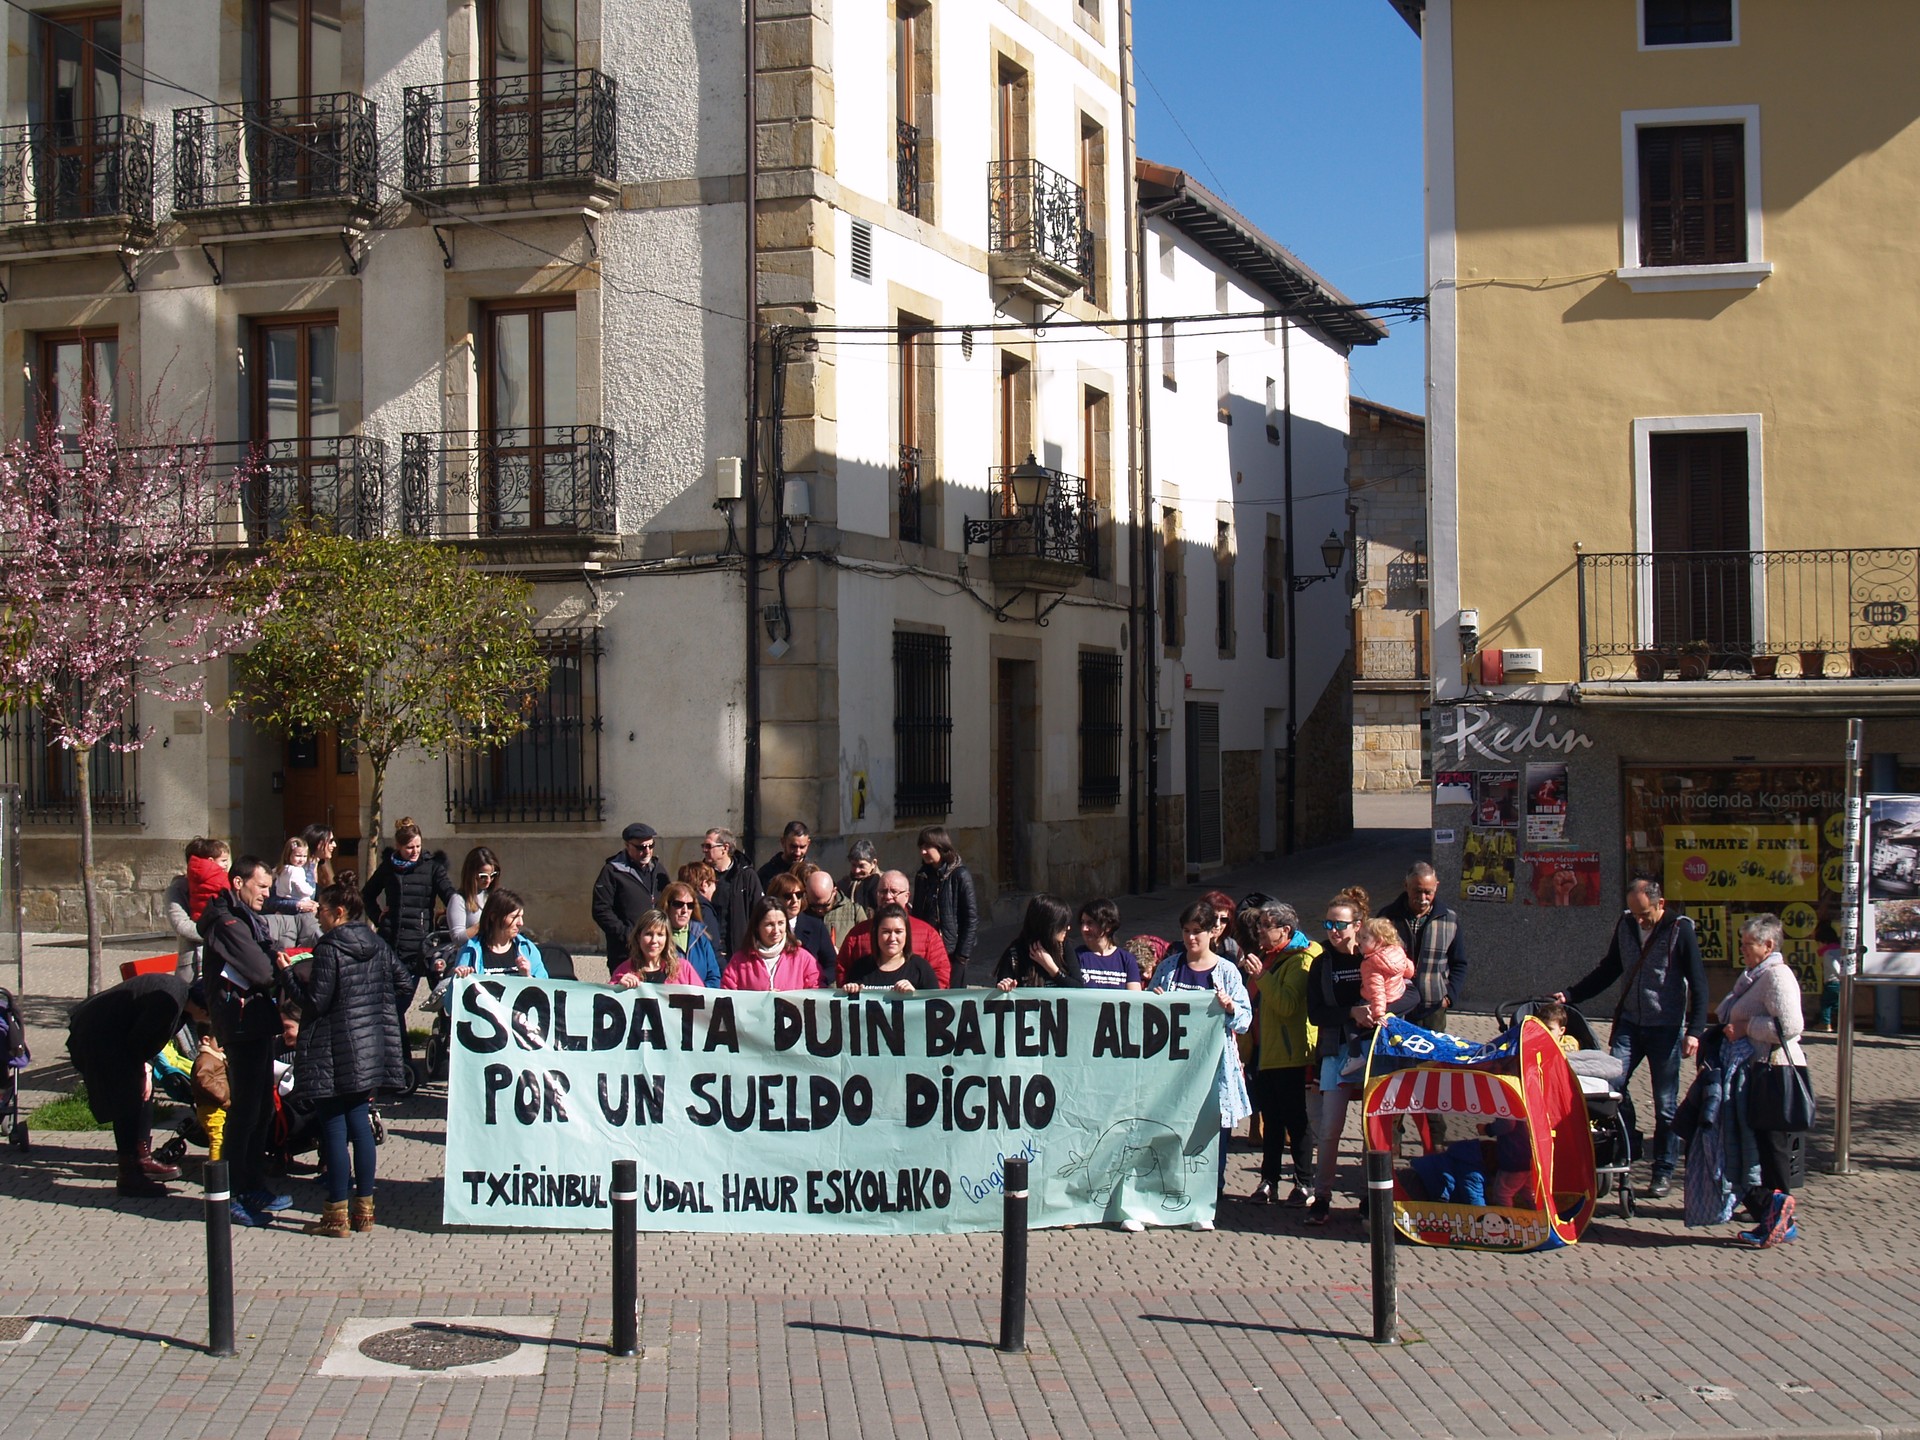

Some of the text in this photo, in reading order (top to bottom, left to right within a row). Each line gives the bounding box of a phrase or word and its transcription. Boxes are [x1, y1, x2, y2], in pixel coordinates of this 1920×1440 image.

[1868, 604, 1903, 622] 1883
[1440, 705, 1594, 763] Redin
[1674, 838, 1810, 850] REMATE FINAL
[1698, 907, 1714, 919] LI
[1795, 941, 1810, 953] LI
[1788, 952, 1816, 965] QUI
[456, 981, 740, 1053] SOLDATA
[925, 998, 1068, 1058] BATEN
[1093, 1001, 1191, 1060] ALDE
[484, 1063, 571, 1126] POR
[597, 1073, 666, 1126] UN
[685, 1072, 873, 1132] SUELDO
[644, 1173, 714, 1213] UDAL
[722, 1169, 798, 1213] HAUR
[806, 1167, 951, 1214] ESKOLAKO
